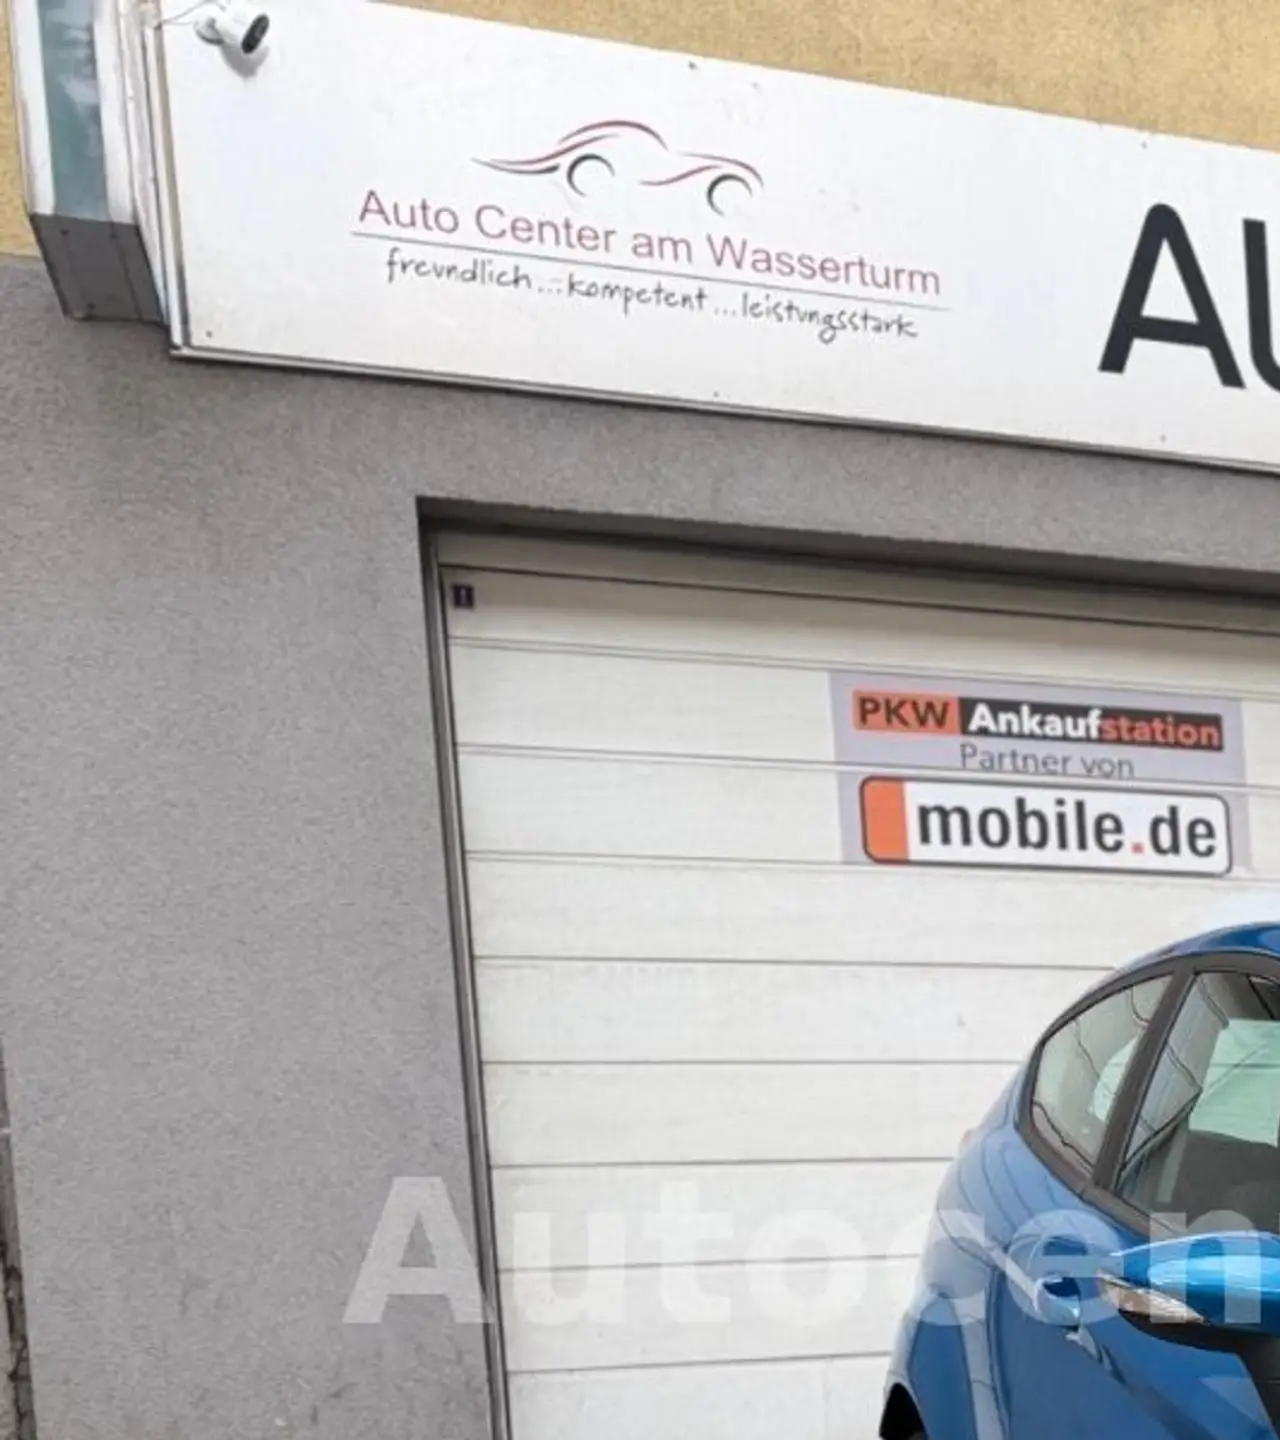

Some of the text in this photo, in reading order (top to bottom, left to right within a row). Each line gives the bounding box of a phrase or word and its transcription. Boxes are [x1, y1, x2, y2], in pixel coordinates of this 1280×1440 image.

[359, 188, 941, 296] Auto Center am Wasserturm
[857, 695, 1223, 747] PKW Ankaufstation
[959, 742, 1136, 779] Partner von
[917, 796, 1218, 859] mobile.de
